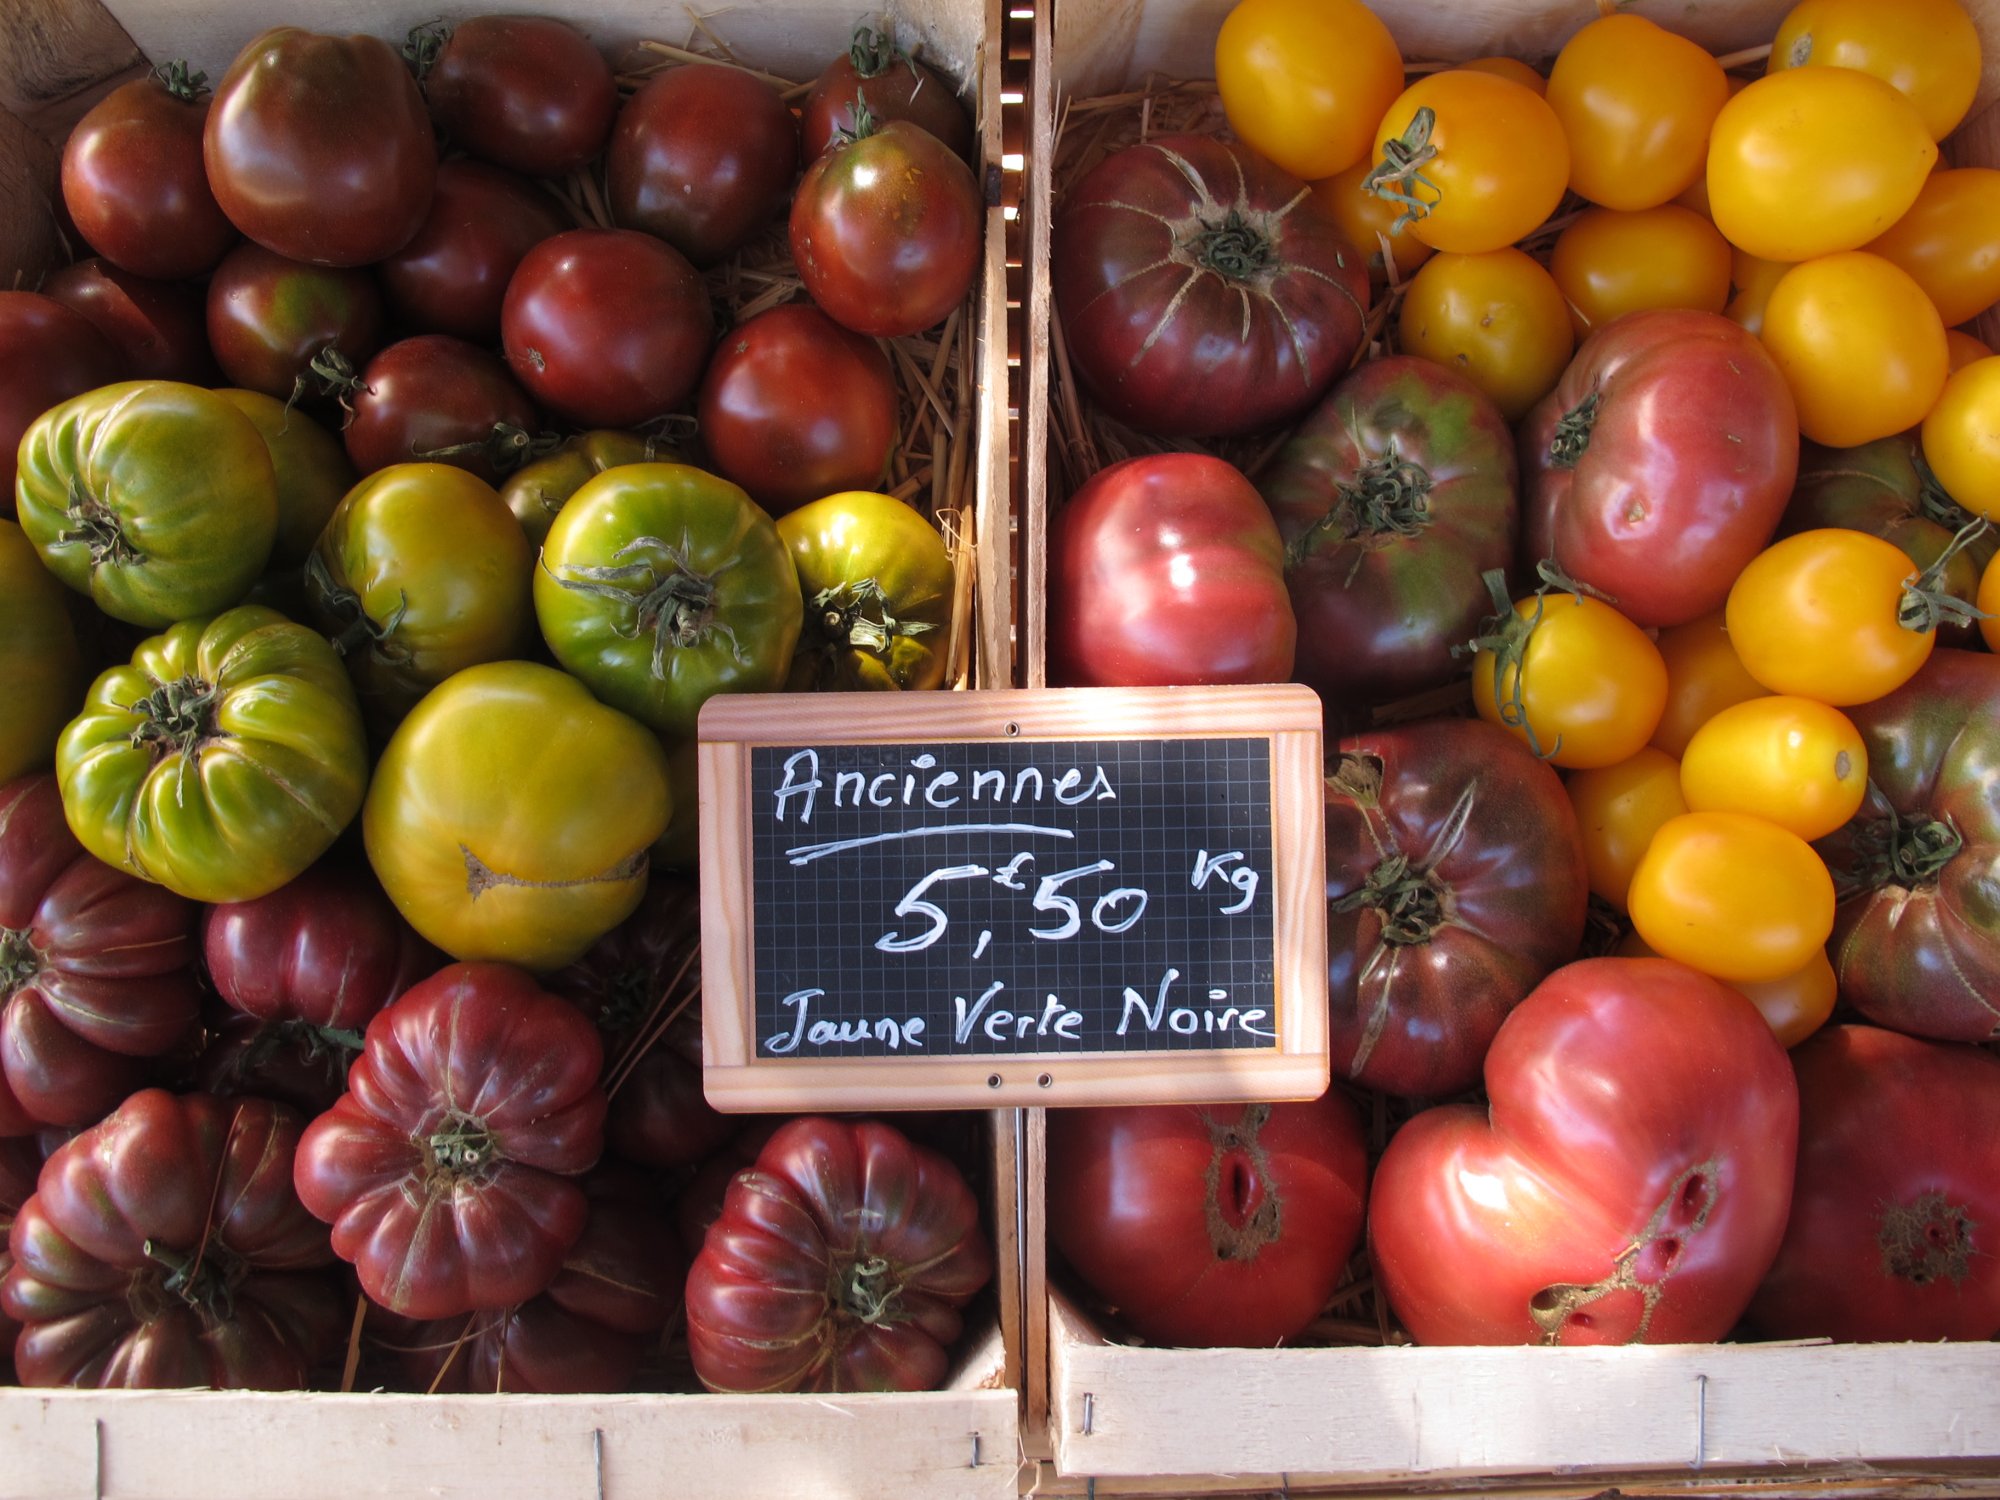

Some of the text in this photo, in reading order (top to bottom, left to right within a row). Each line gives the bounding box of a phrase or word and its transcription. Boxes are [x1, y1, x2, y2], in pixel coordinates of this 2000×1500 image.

[774, 748, 1117, 824] Anciennes
[1191, 849, 1259, 915] Kg
[765, 968, 1279, 1053] Jaune Verte Noire
